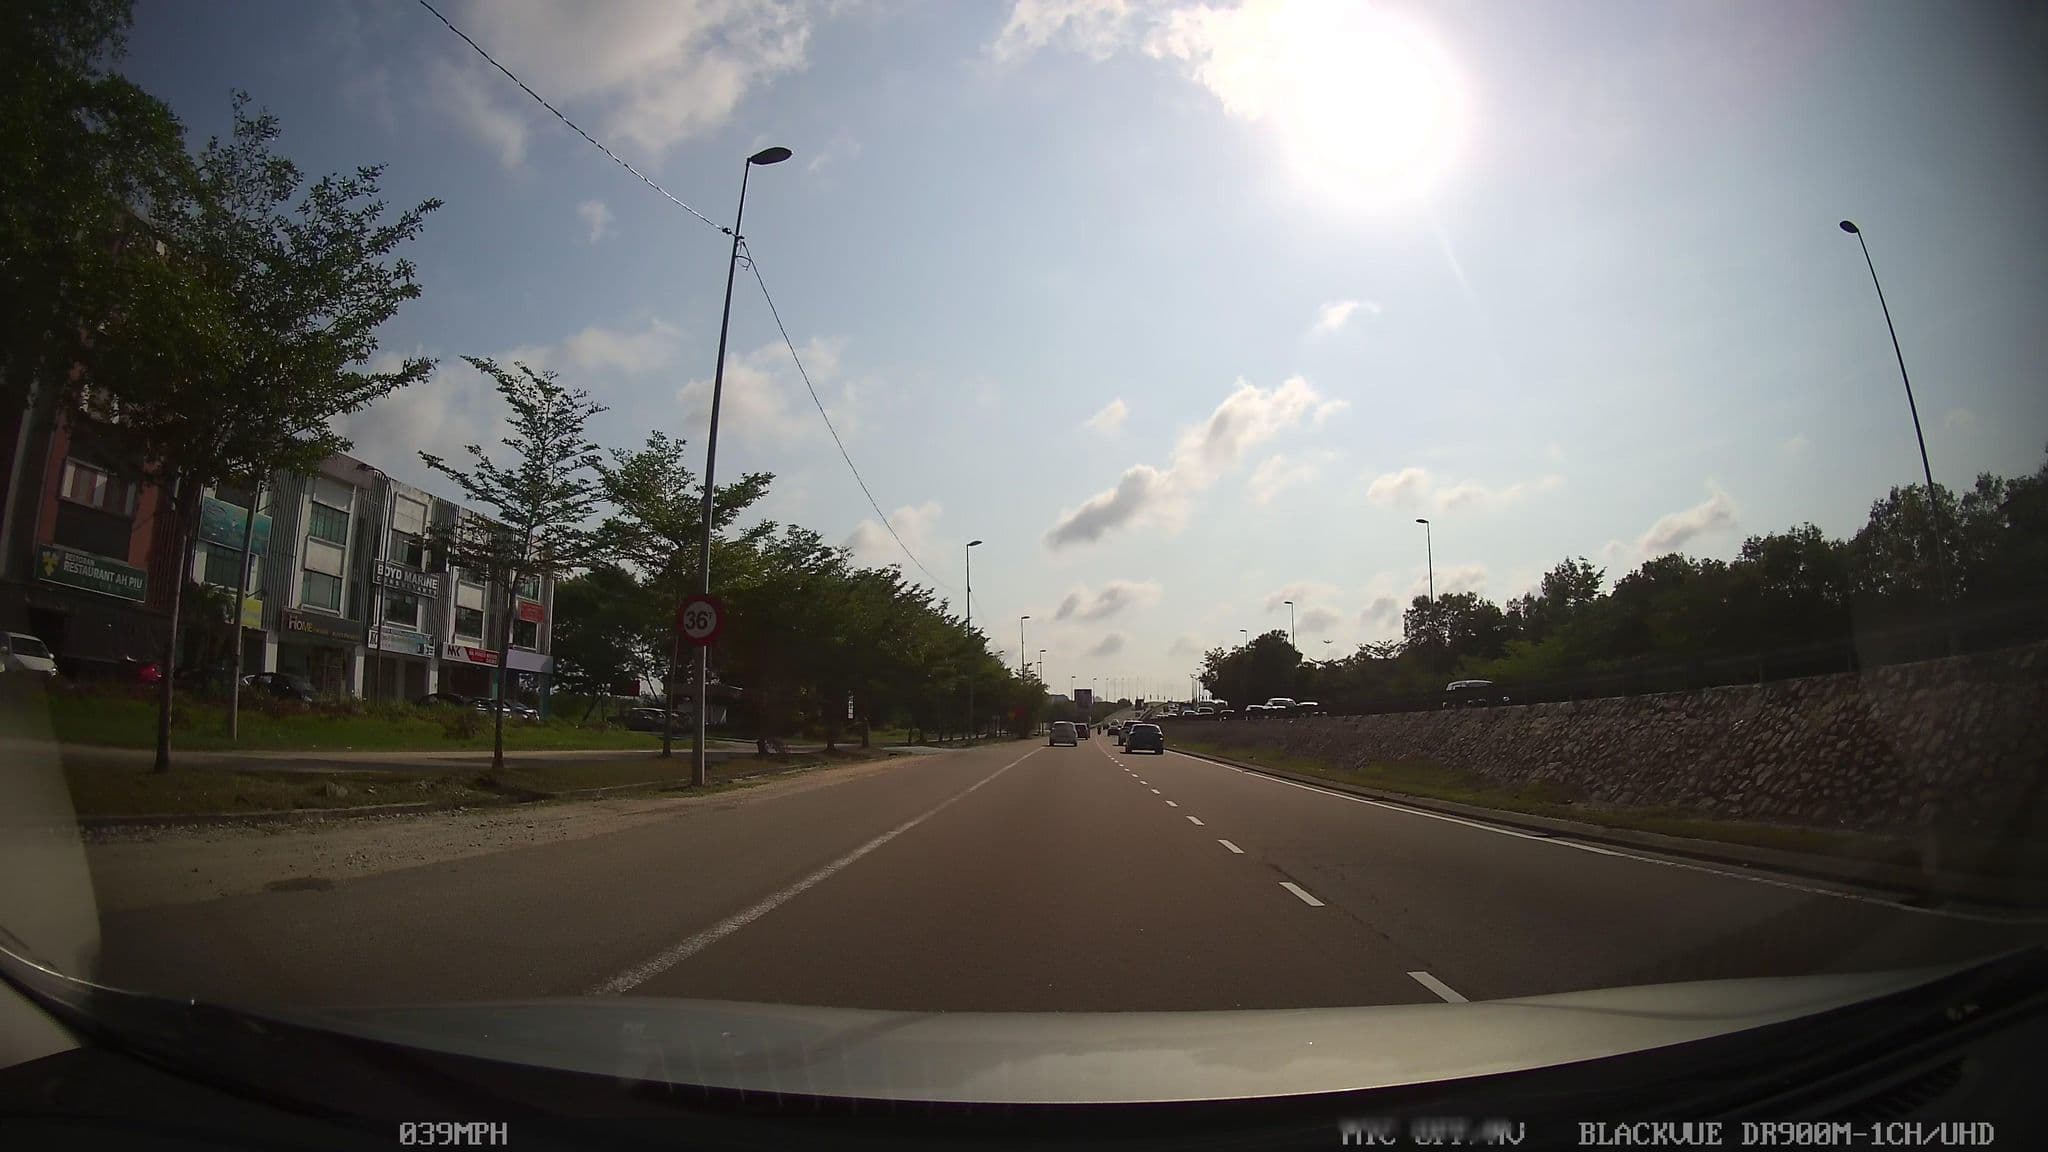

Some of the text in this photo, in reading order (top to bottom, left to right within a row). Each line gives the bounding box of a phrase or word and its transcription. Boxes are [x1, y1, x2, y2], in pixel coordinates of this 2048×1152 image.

[64, 561, 115, 582] RESTAURANT
[115, 573, 127, 586] AH
[129, 576, 143, 589] PIU
[377, 564, 438, 590] BOYD MARINE
